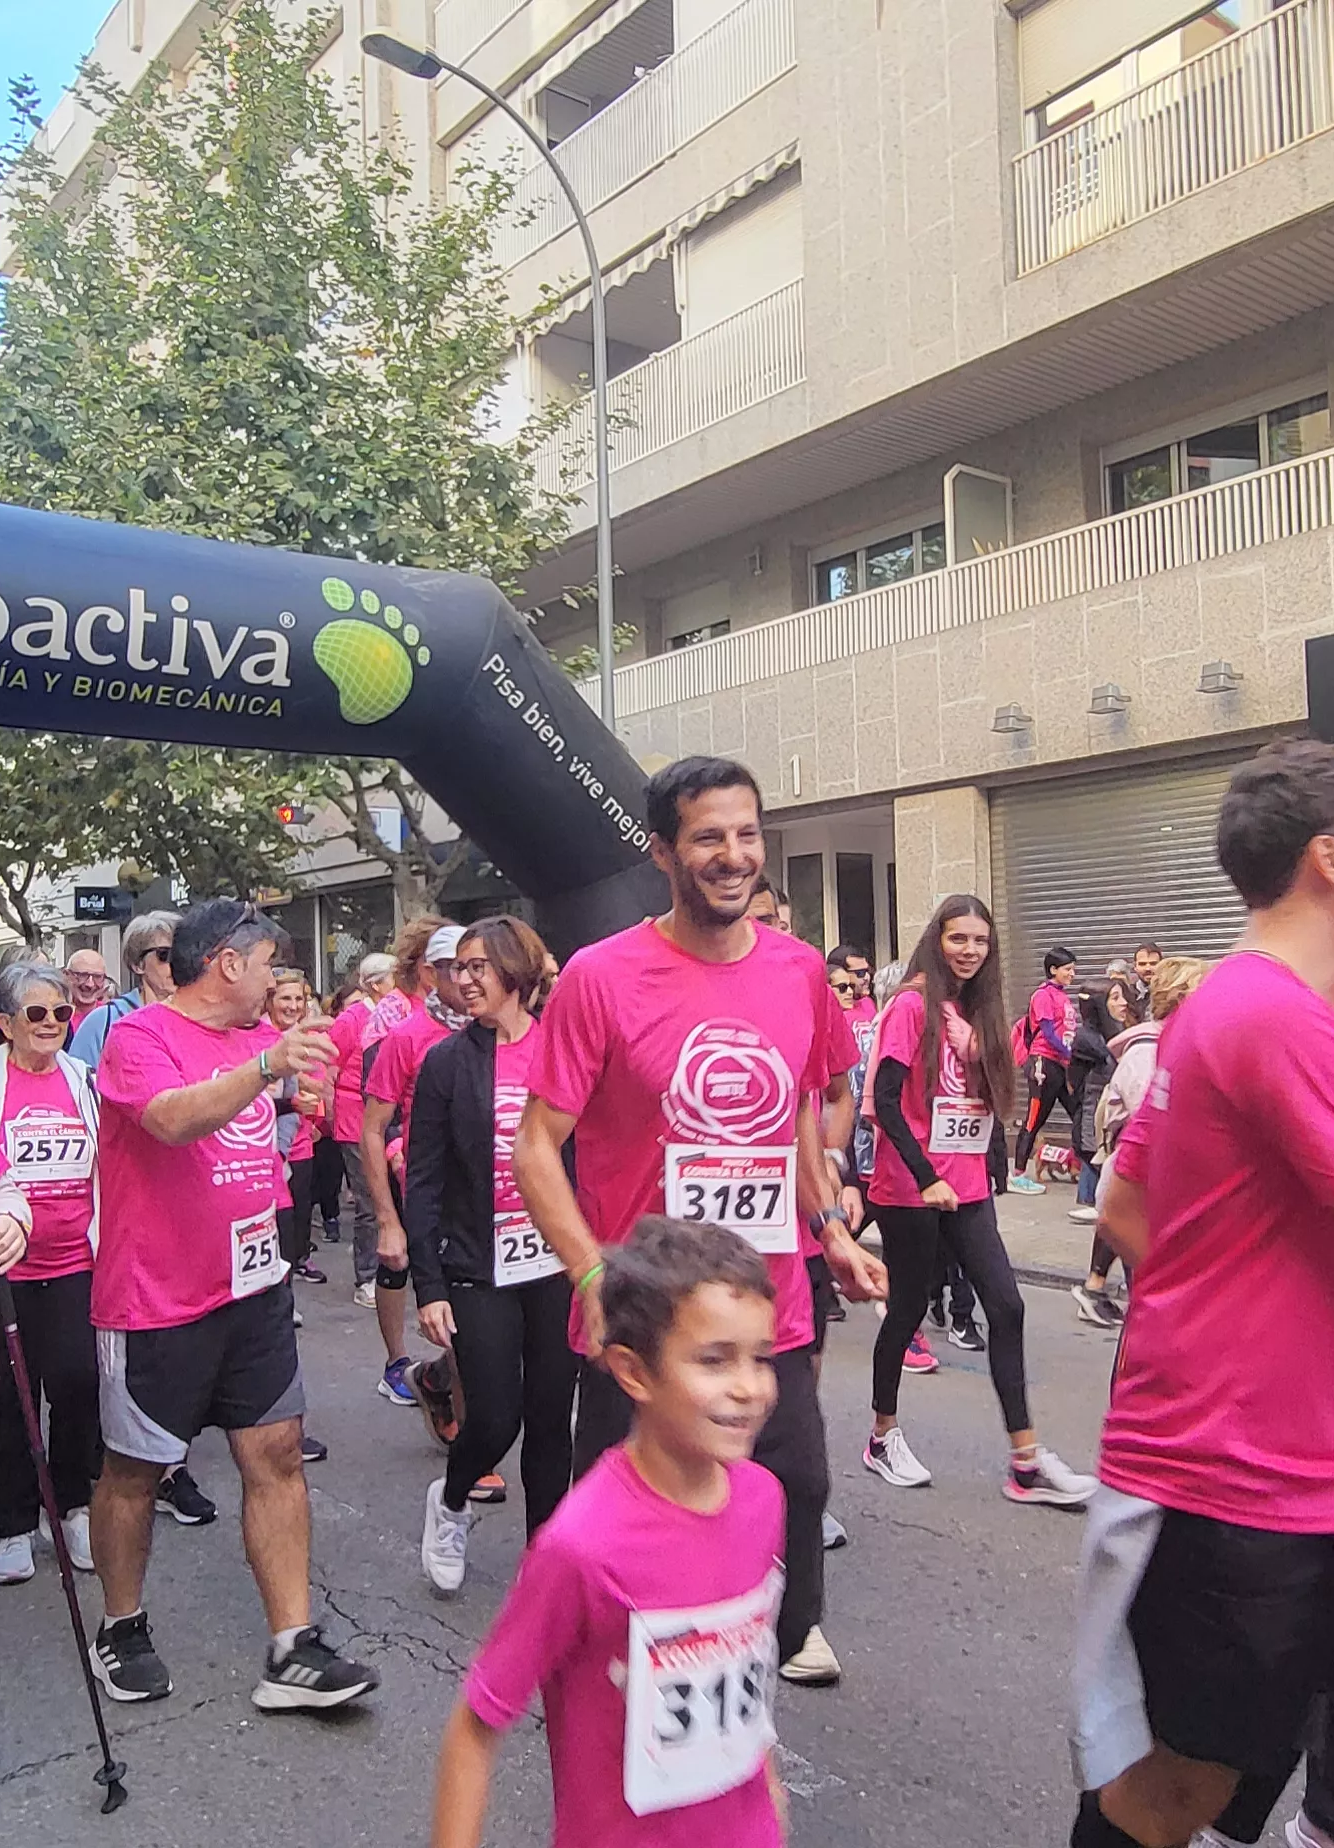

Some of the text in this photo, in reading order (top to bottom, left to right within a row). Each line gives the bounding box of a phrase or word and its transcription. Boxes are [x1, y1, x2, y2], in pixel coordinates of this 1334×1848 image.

[44, 672, 58, 693] Y
[72, 675, 285, 718] BIOMECÁNICA
[482, 653, 526, 710] Pisa
[521, 702, 566, 762] bien,
[568, 756, 605, 799] vive
[945, 1118, 982, 1138] 366
[17, 1139, 87, 1163] 2577
[683, 1184, 782, 1220] 3187
